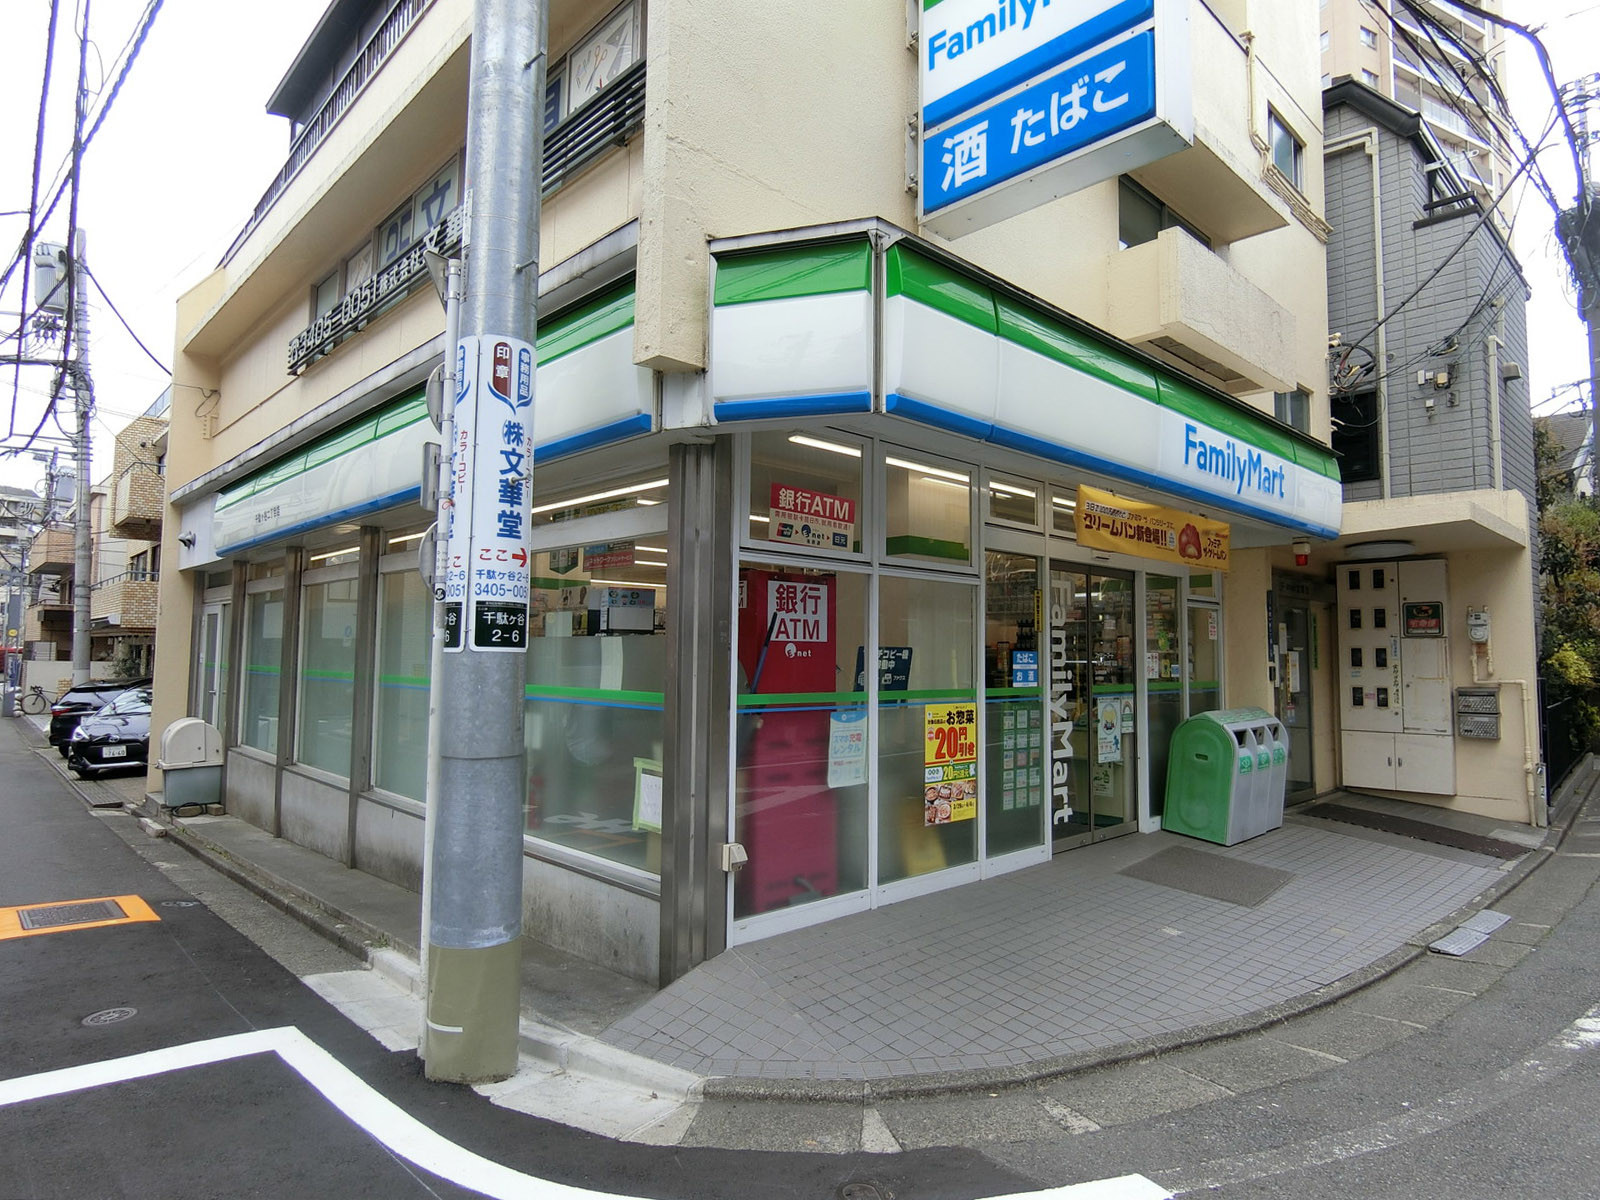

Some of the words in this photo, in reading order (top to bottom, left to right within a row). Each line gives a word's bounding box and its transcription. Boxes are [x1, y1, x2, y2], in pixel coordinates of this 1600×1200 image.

[928, 0, 1055, 72] Family
[941, 119, 989, 192] 酒
[1010, 60, 1129, 154] たばこ
[496, 346, 510, 379] 印章
[458, 430, 468, 494] カラーコピー
[1184, 422, 1285, 499] FamilyMart
[778, 487, 850, 521] 銀行ATM
[479, 548, 508, 562] ここ
[775, 583, 822, 615] 銀行
[491, 629, 520, 643] 2-6
[775, 618, 820, 640] ATM
[1015, 652, 1034, 663] たばこ
[946, 709, 975, 726] お惣菜
[1051, 579, 1074, 825] FamilyMart
